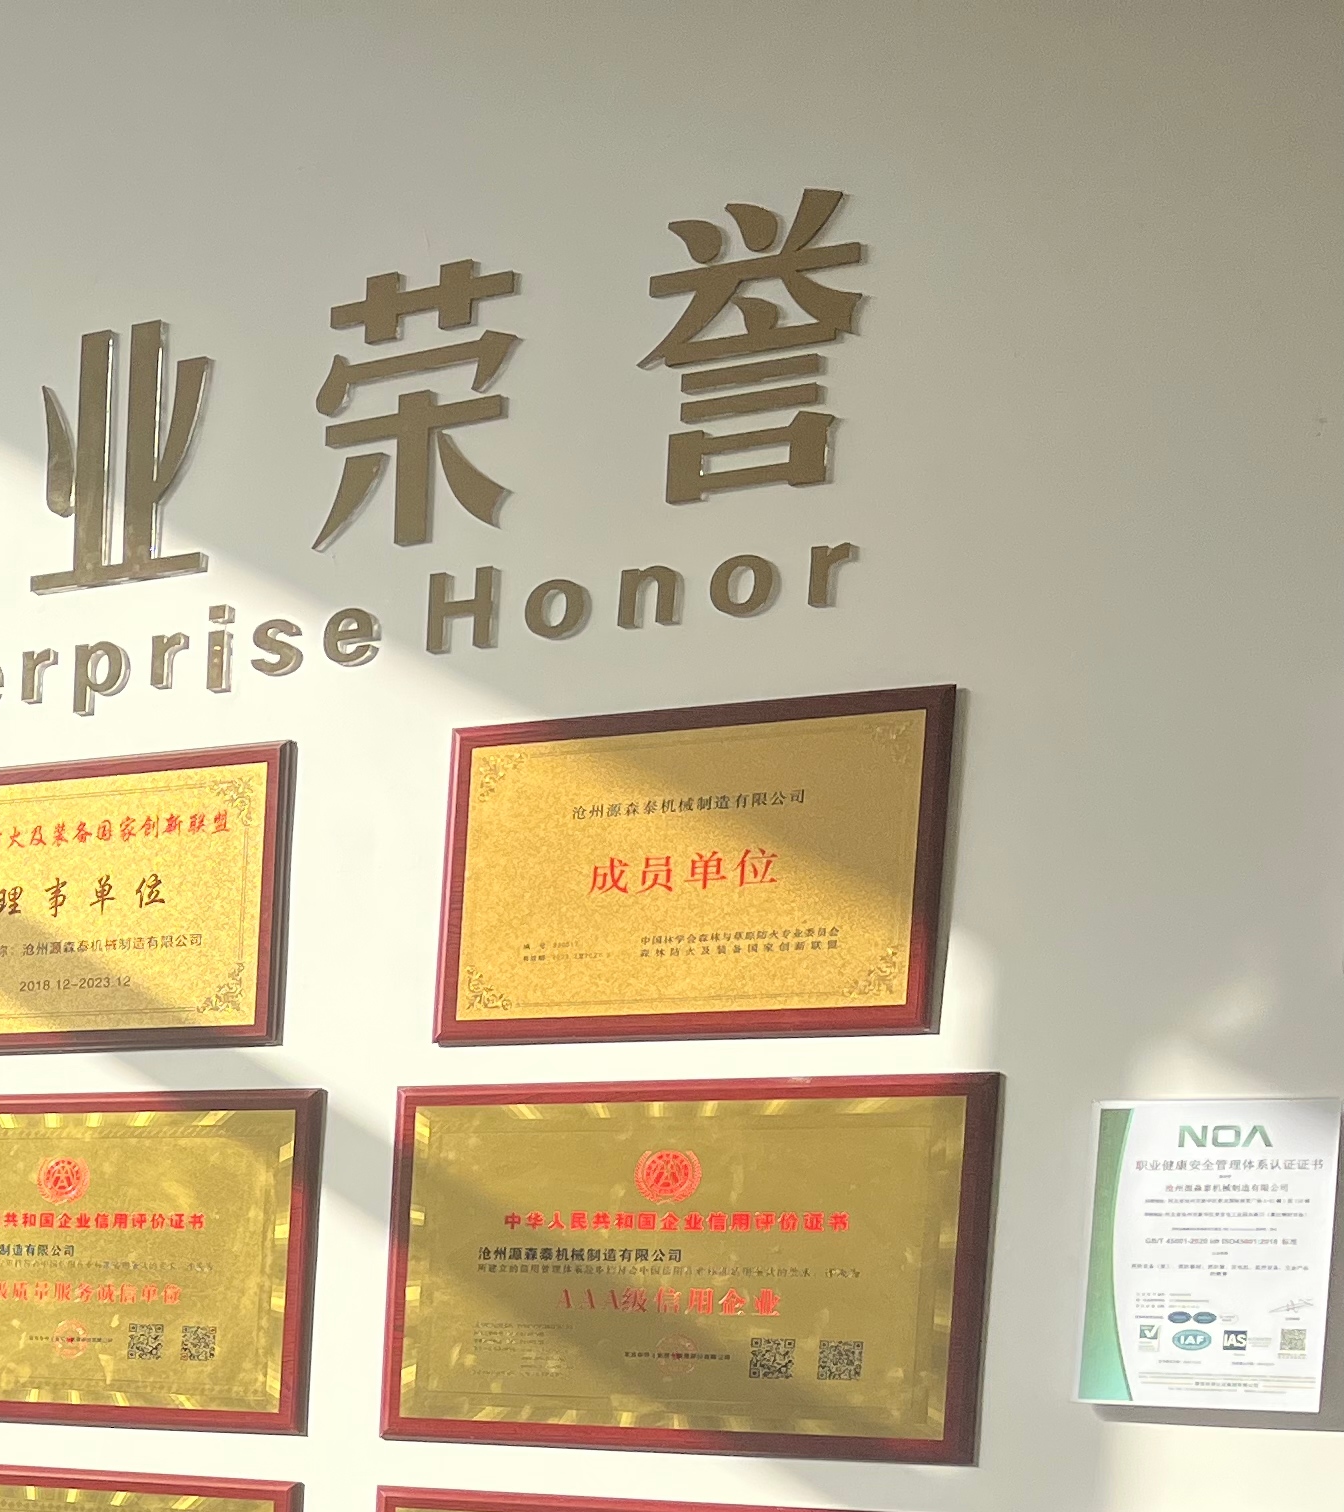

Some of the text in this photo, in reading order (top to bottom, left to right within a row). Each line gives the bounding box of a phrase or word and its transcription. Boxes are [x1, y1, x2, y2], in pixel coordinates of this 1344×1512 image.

[425, 541, 860, 654] Honor
[572, 789, 806, 820] 沧州源森泰机械制造有限公司
[587, 847, 780, 896] 成员单位
[504, 1211, 851, 1233] 中华人民共和国企业信用评价证书
[477, 1246, 683, 1263] 沧州源森泰机械制造有限公司
[558, 1287, 782, 1316] AAA级信用企业
